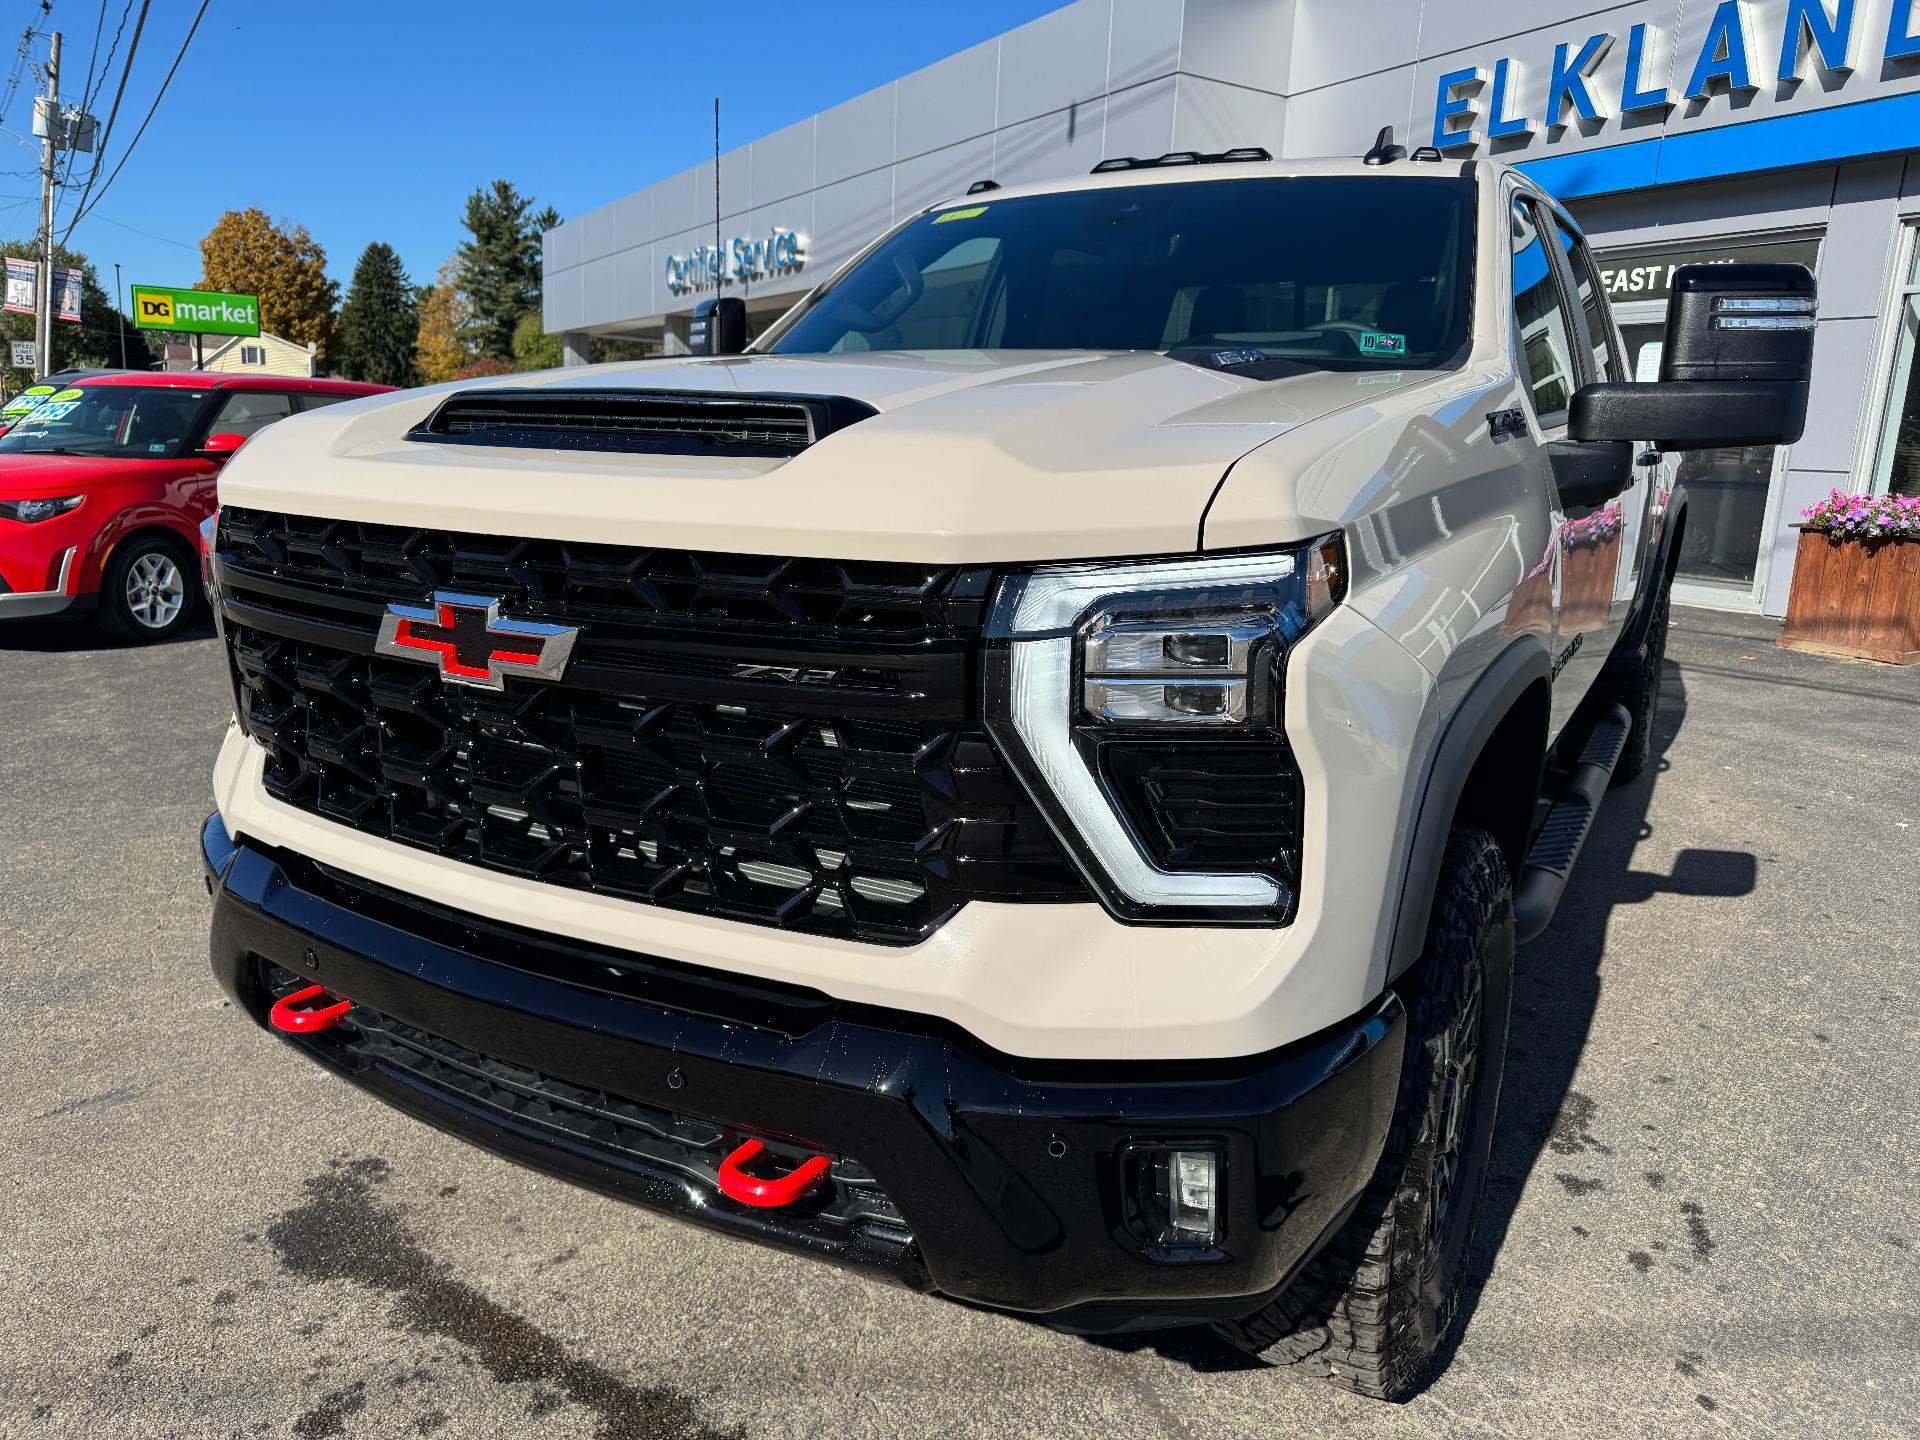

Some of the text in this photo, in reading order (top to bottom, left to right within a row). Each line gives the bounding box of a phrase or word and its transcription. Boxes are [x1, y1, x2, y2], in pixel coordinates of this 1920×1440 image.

[666, 227, 798, 290] Certified Service
[1601, 264, 1662, 294] EAST
[141, 301, 255, 324] DG market
[15, 354, 35, 365] 35
